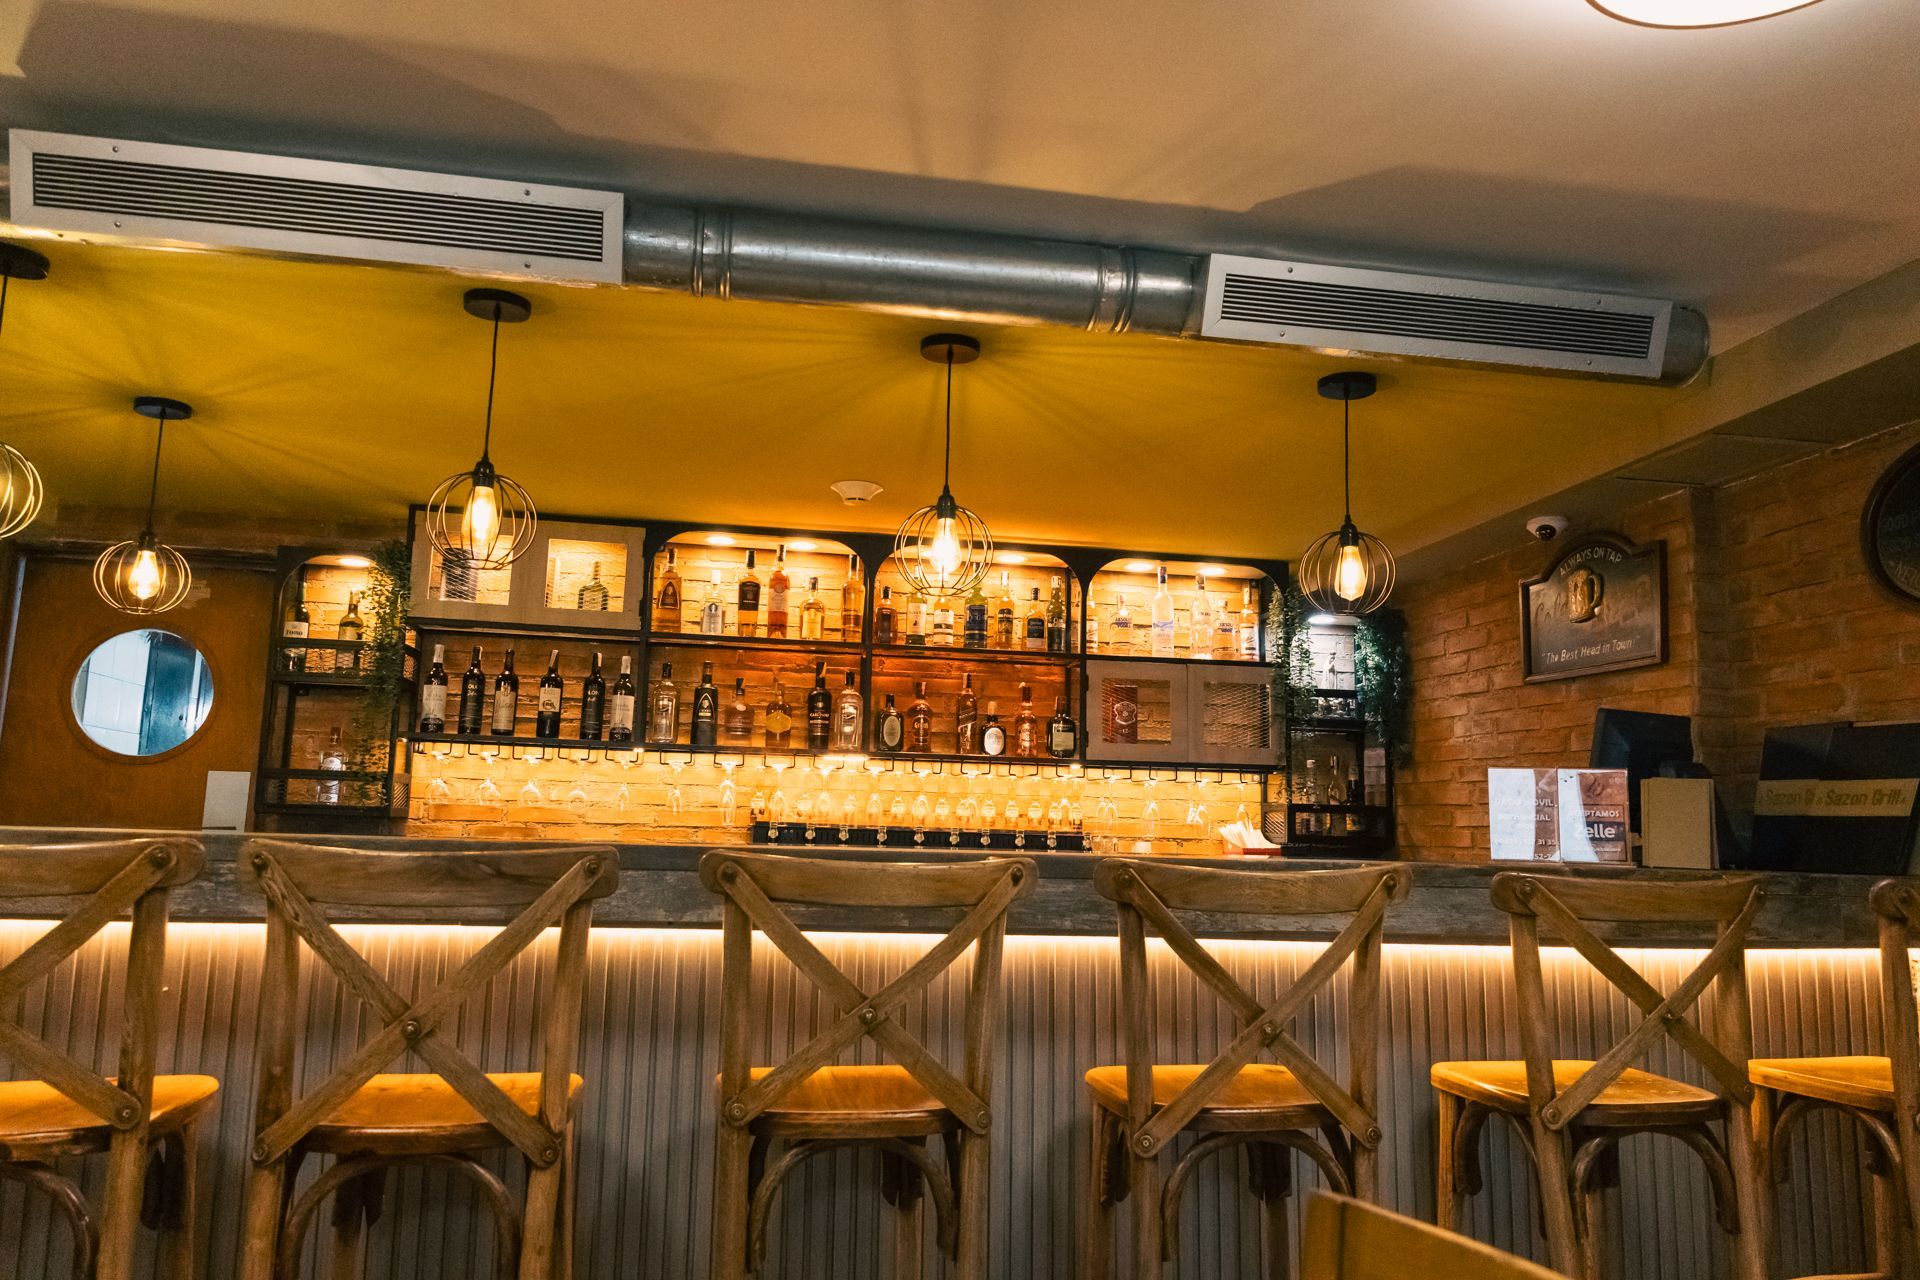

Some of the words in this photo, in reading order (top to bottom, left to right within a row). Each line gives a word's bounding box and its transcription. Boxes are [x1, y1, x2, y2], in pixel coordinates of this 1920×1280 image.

[1560, 548, 1591, 576] ALWAYS
[1593, 546, 1604, 559] ON
[1605, 547, 1622, 563] TAP
[1560, 649, 1577, 662] Best
[1580, 645, 1600, 658] Head
[1602, 643, 1610, 653] in
